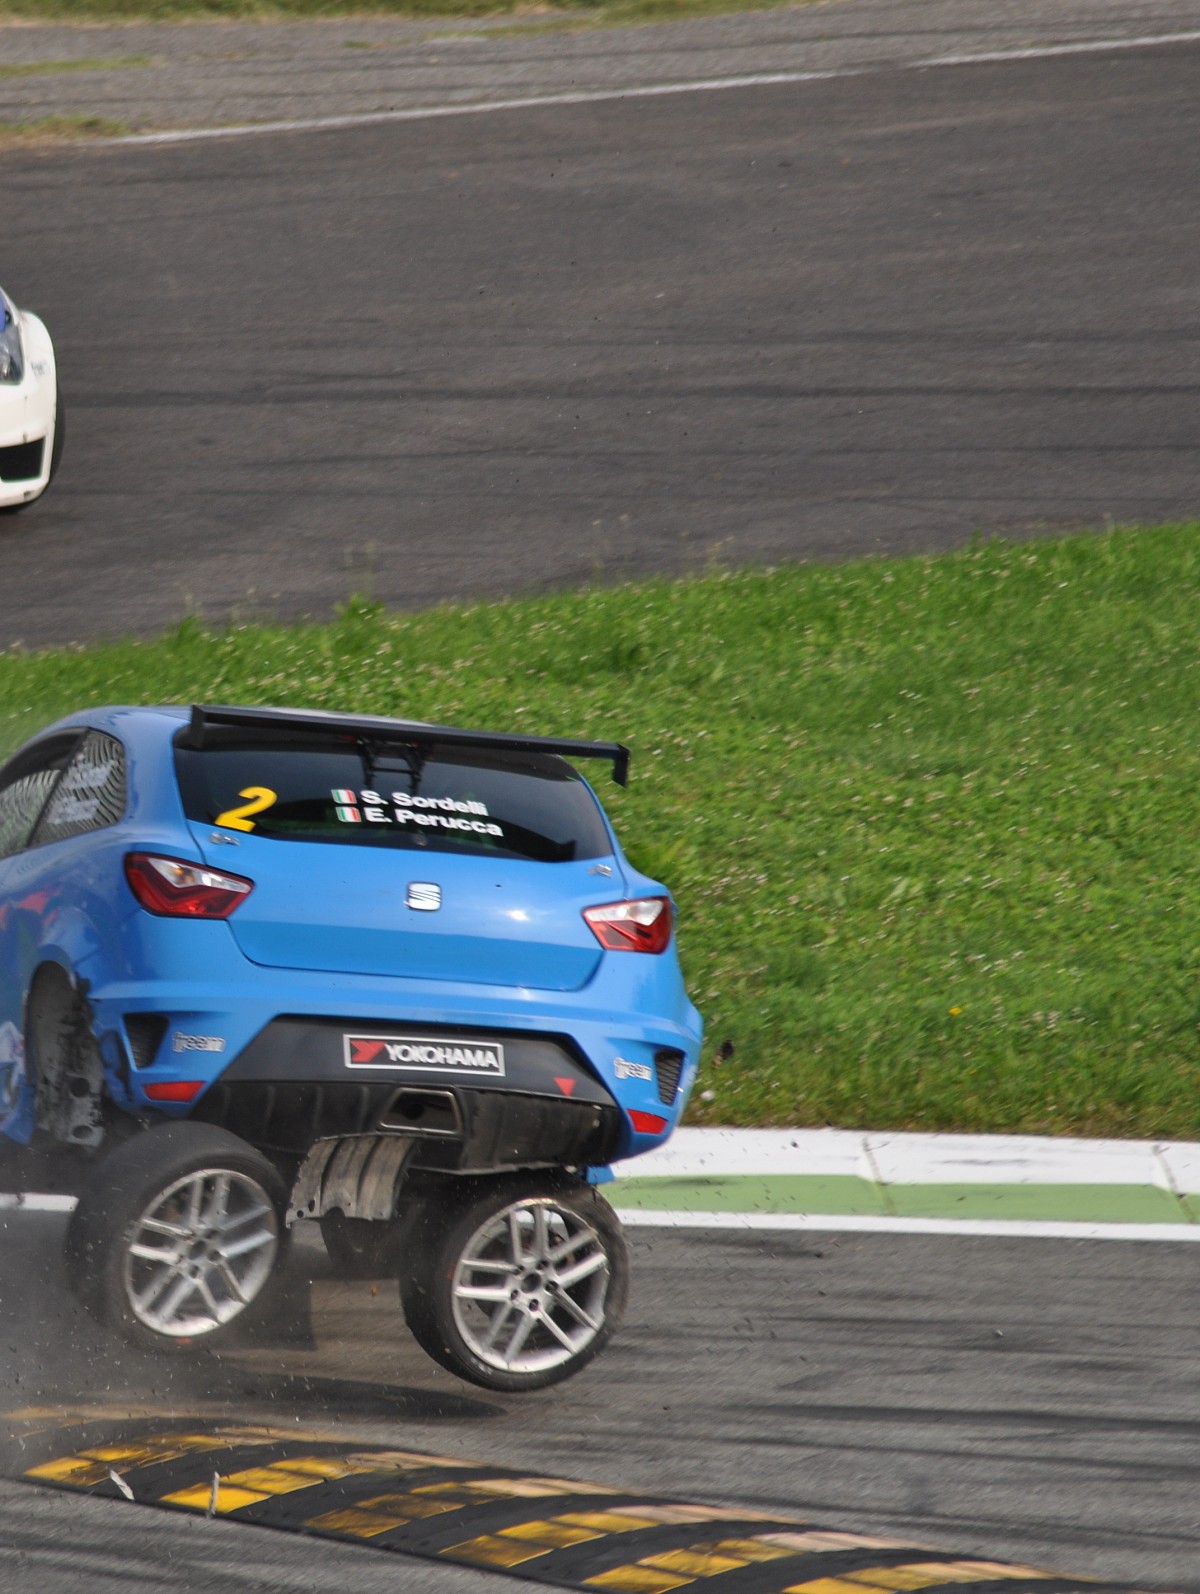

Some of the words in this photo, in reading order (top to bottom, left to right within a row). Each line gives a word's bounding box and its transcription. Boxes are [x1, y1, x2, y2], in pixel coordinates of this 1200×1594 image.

[214, 786, 278, 832] 2
[360, 789, 389, 805] S.
[391, 791, 489, 816] Sordelli
[363, 807, 393, 823] E.
[394, 808, 504, 837] Perucca
[384, 1043, 500, 1068] YOKOHAMA
